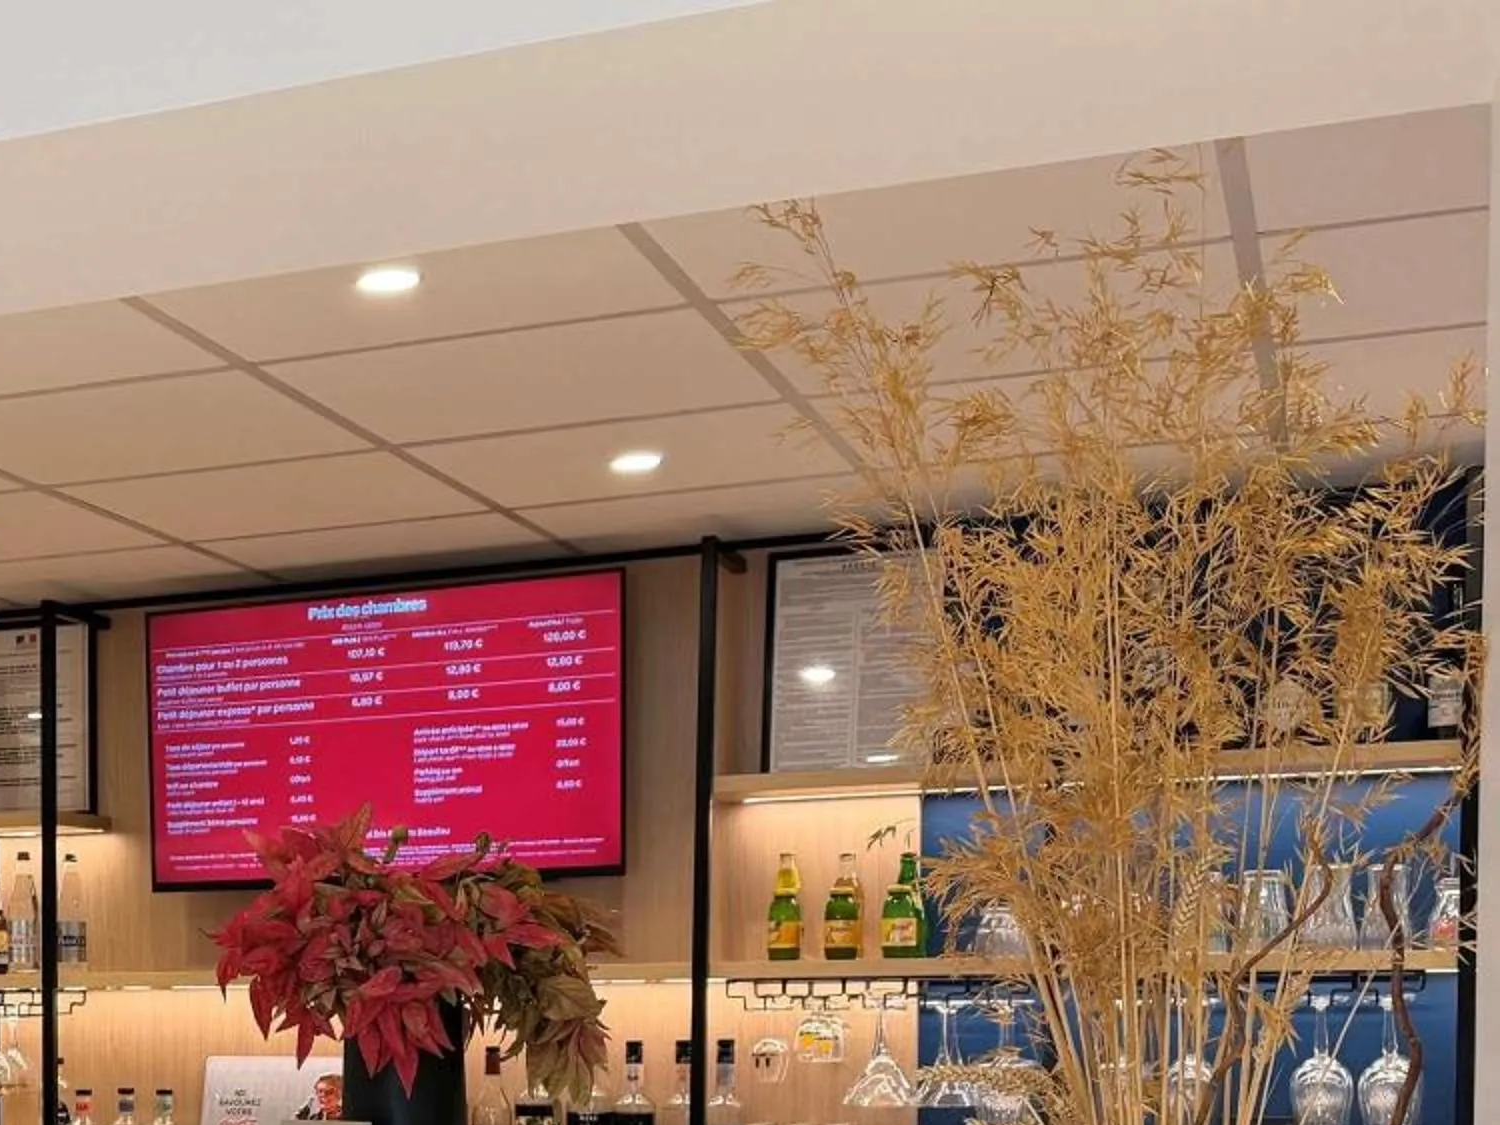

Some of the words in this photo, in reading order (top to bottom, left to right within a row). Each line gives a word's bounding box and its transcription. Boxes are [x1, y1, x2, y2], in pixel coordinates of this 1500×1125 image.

[308, 605, 334, 620] Prix
[336, 603, 360, 618] des
[361, 598, 427, 616] chambres
